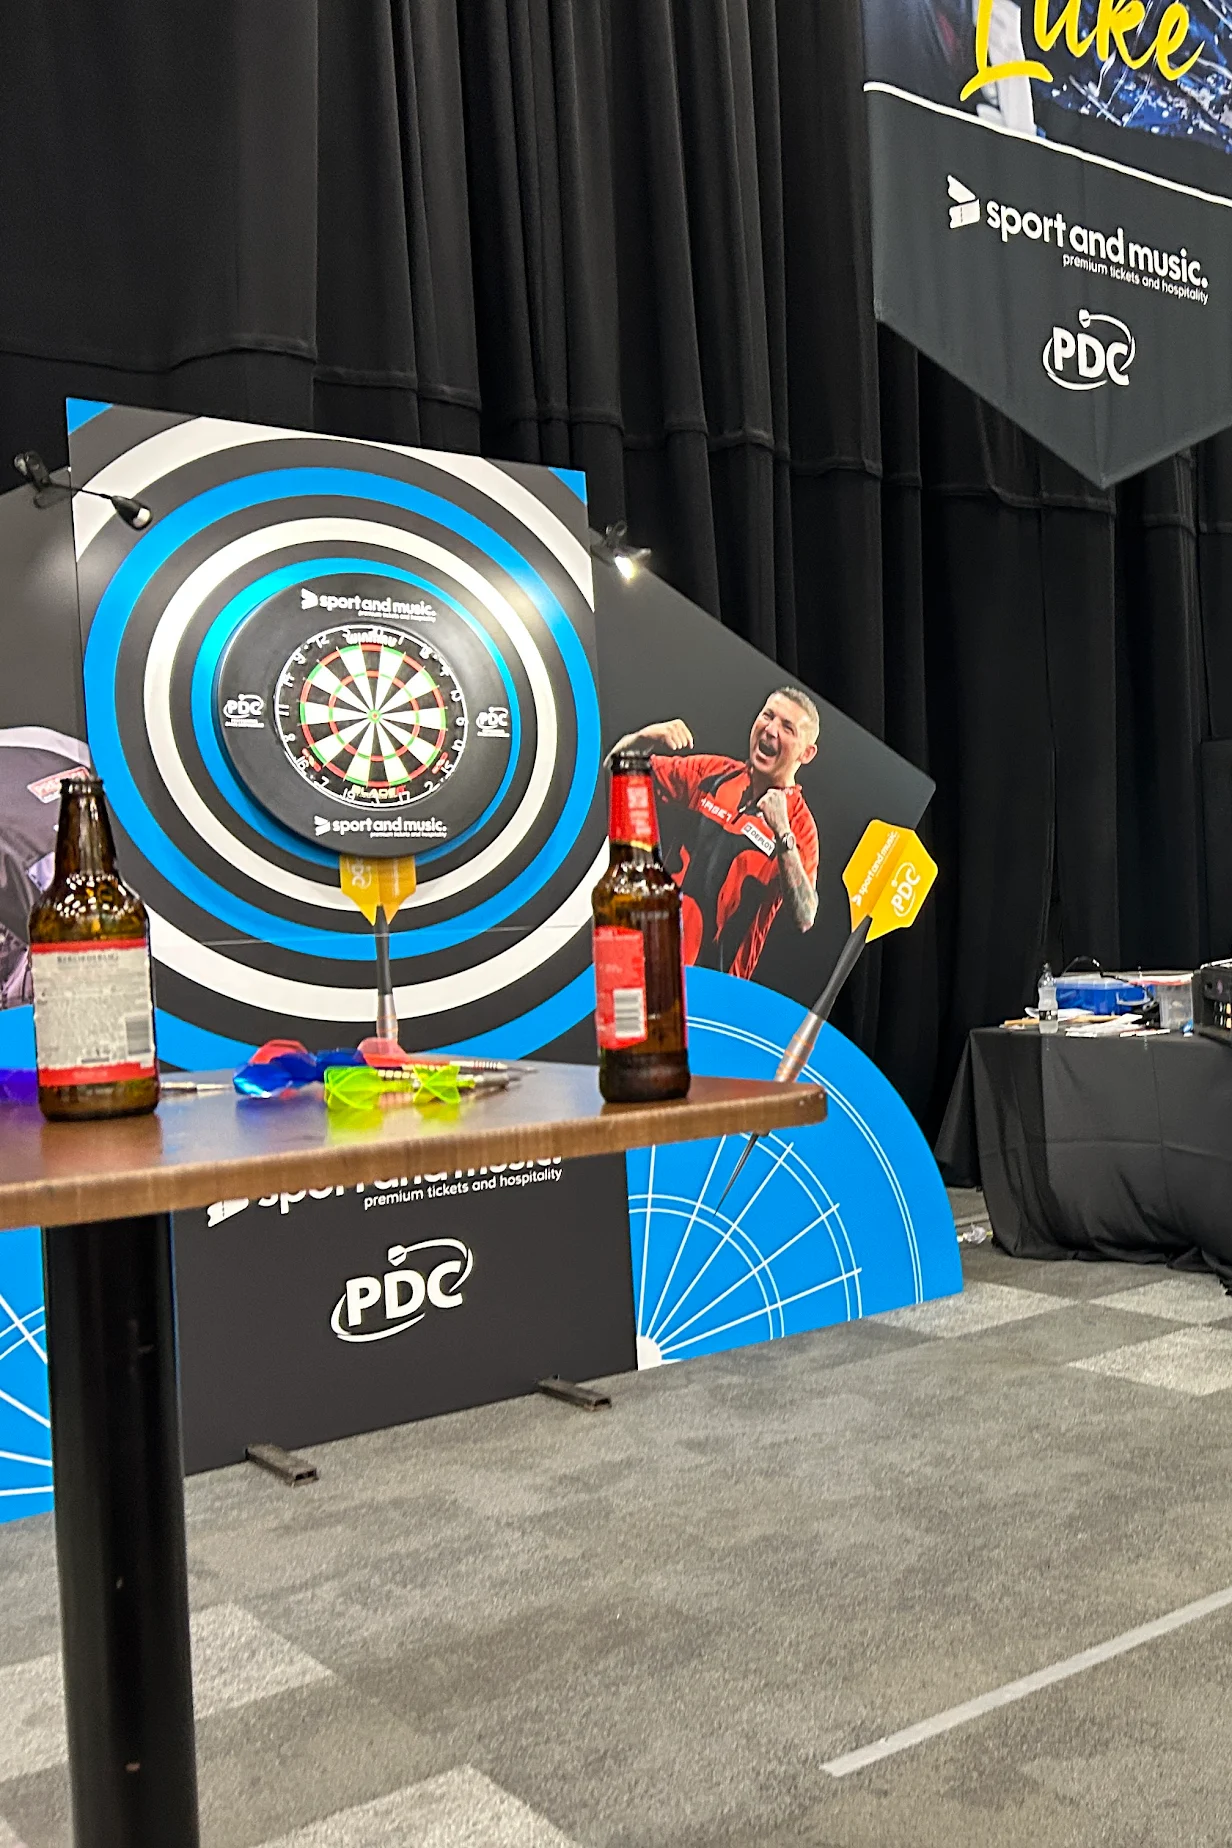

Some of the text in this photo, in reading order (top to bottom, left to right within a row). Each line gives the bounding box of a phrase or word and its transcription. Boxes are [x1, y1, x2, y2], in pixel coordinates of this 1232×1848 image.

[960, 0, 1205, 101] Luke
[986, 200, 1209, 289] sport and music.
[1062, 253, 1209, 306] premium tickets and hospitality
[1053, 326, 1131, 387] PDC
[319, 594, 361, 612] sport
[361, 596, 392, 613] and
[227, 699, 262, 716] PDC
[478, 711, 508, 727] PDC
[333, 817, 447, 836] sport and music.
[750, 829, 773, 851] DEPLOY
[891, 867, 921, 911] PDC
[364, 1190, 425, 1211] premium
[427, 1181, 470, 1200] tickets
[472, 1175, 497, 1193] and
[499, 1166, 564, 1188] hospitality
[346, 1260, 463, 1327] PDC
